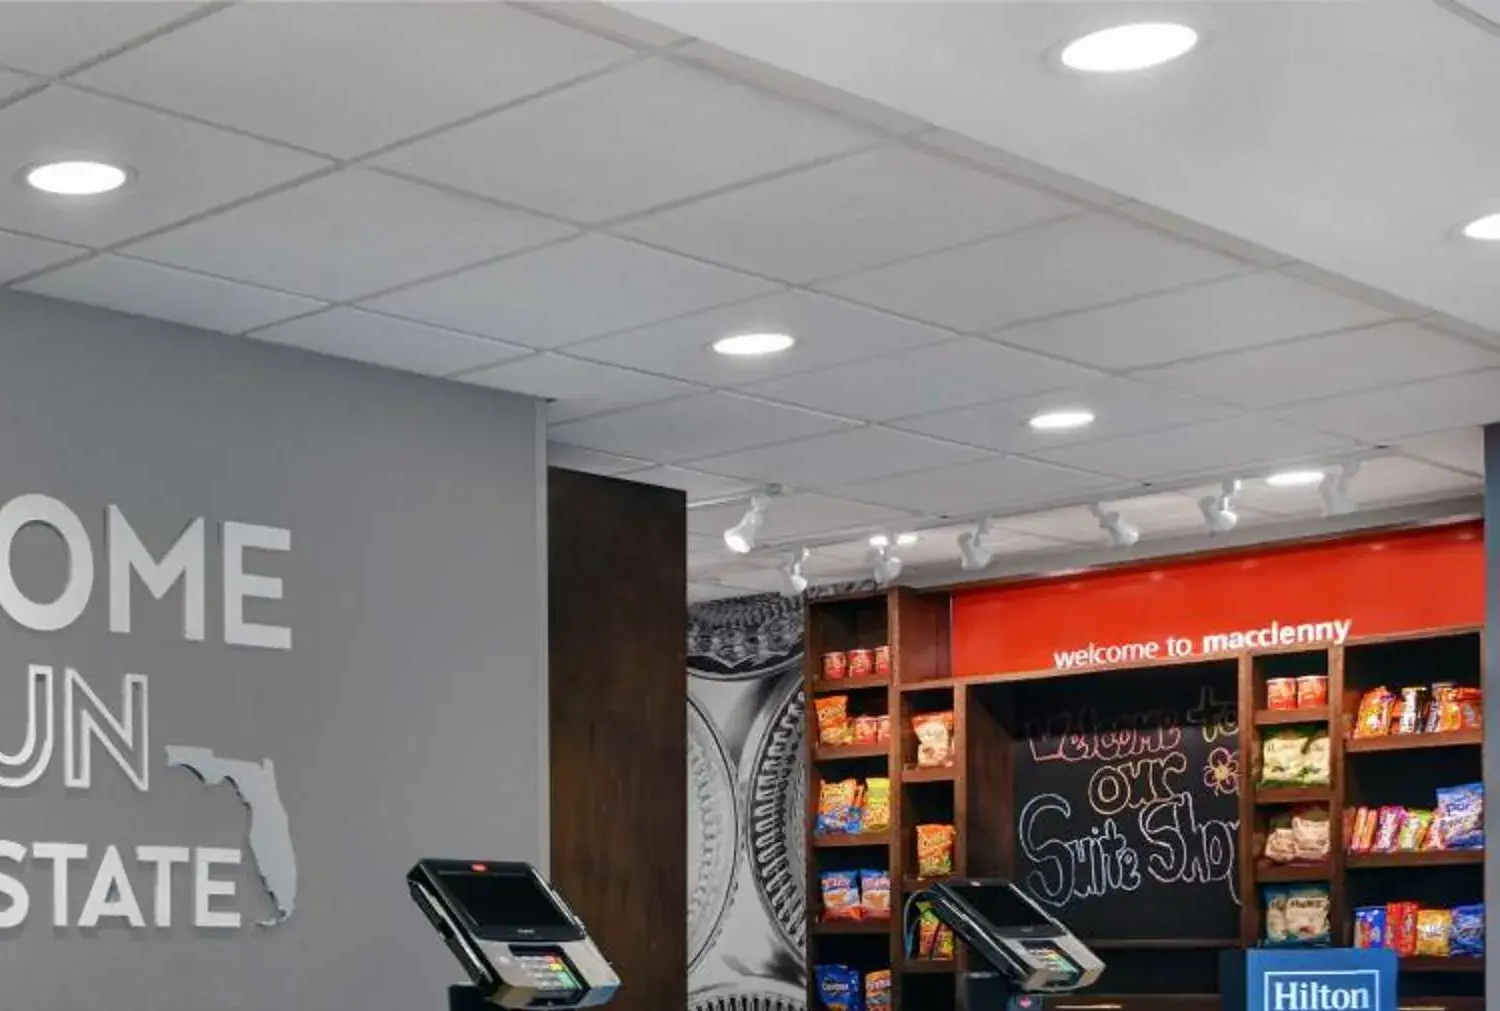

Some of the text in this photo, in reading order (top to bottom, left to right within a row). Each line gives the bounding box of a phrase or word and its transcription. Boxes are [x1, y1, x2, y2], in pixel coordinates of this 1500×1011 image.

[1053, 617, 1352, 670] welcome to macclenny
[1088, 751, 1187, 815] our
[1019, 793, 1141, 907] Suite
[1273, 980, 1370, 1011] Hilton
